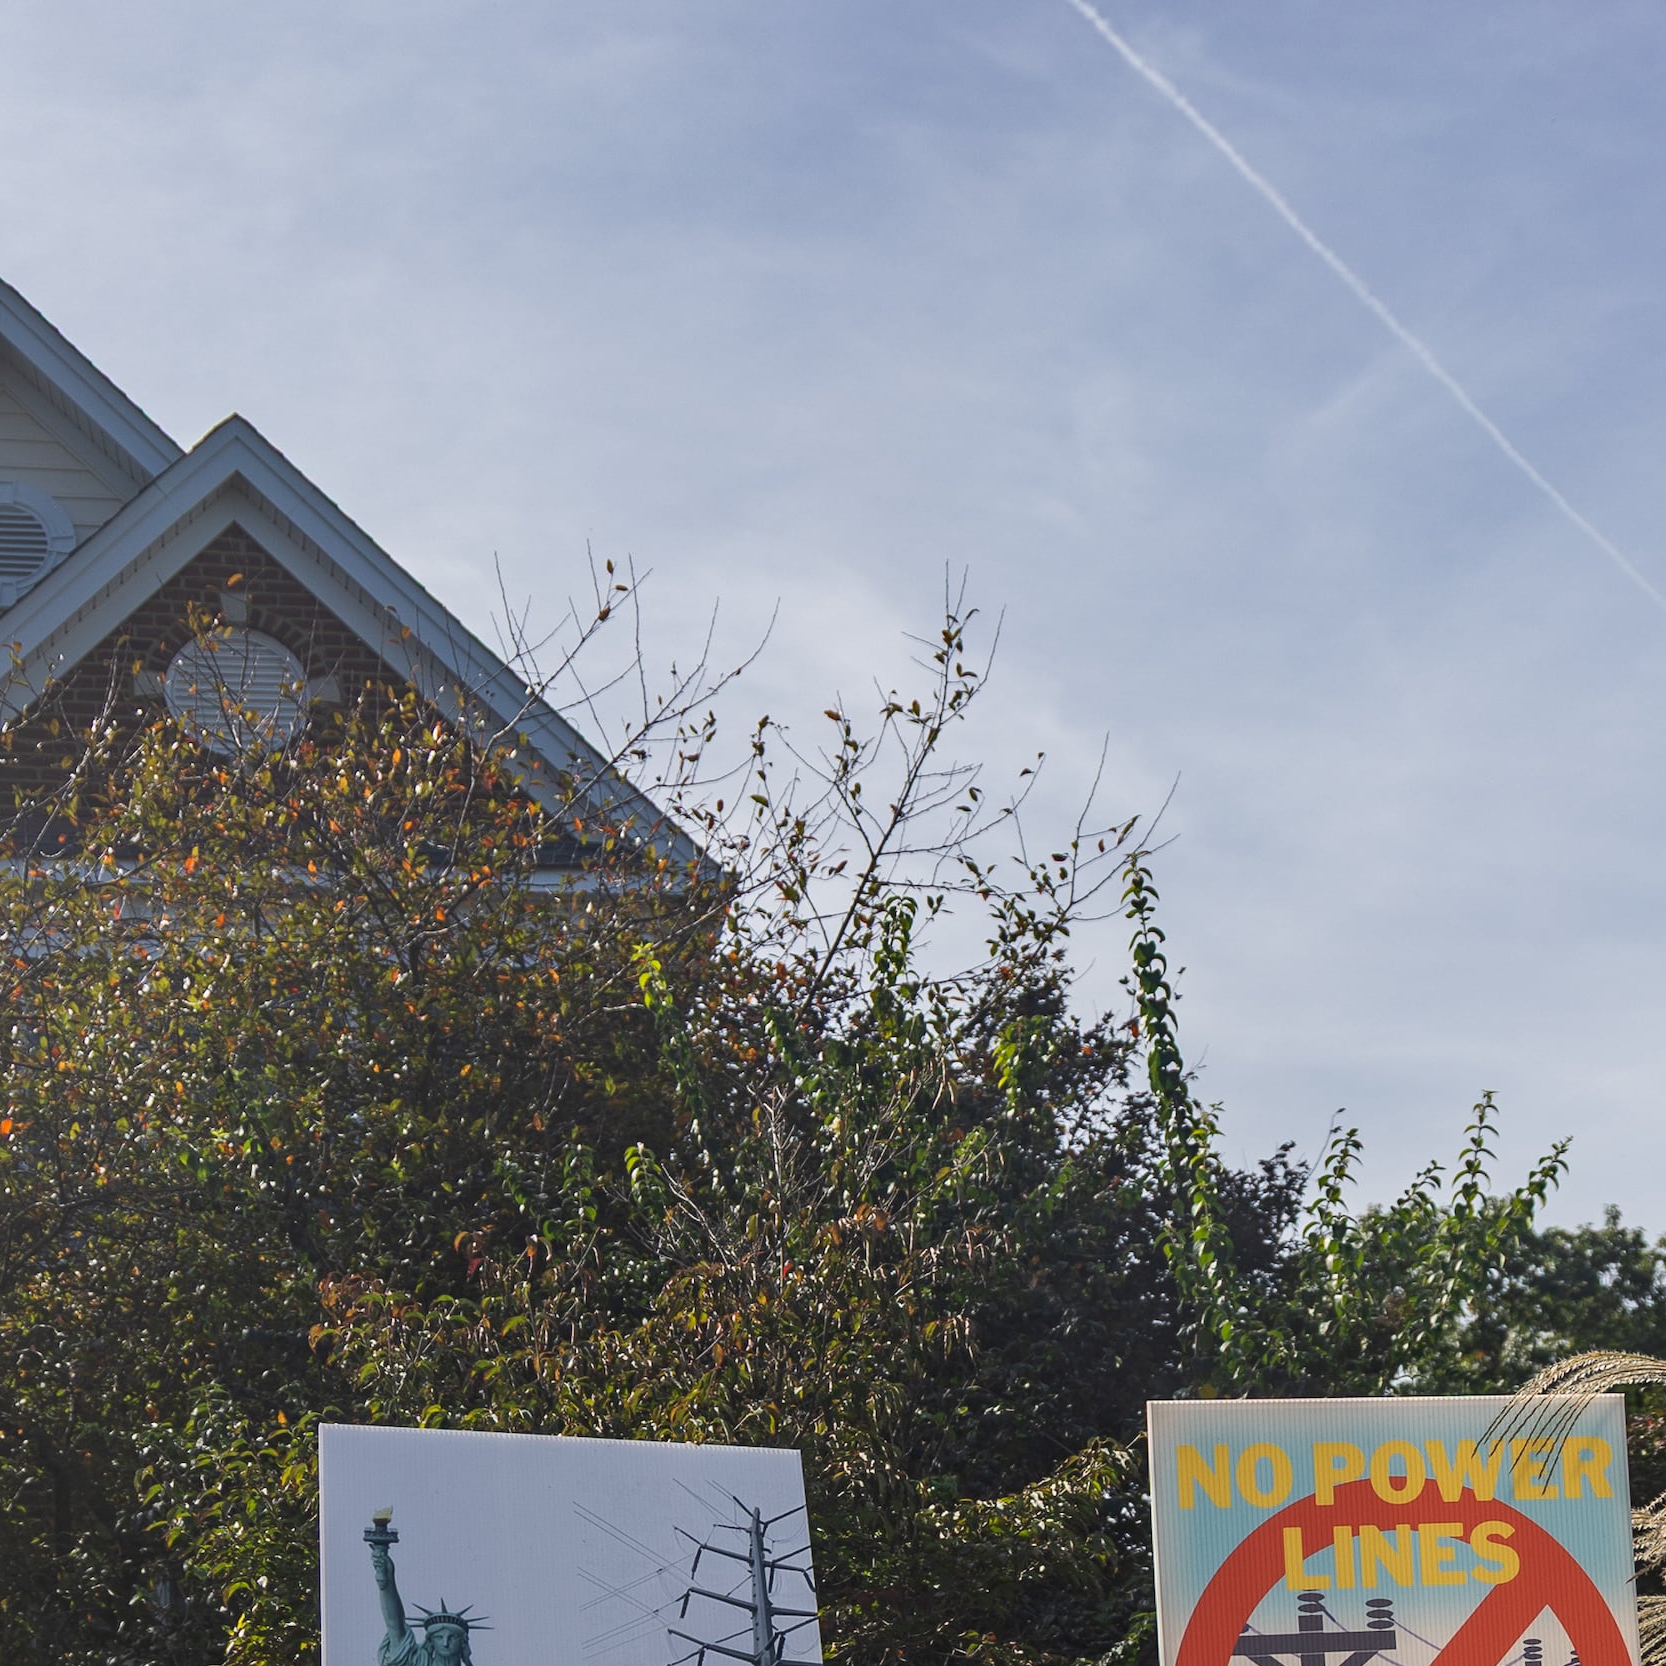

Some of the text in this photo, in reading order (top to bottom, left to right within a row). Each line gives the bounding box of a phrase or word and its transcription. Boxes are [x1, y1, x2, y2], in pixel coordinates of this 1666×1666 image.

[1176, 1436, 1613, 1510] NO POWER
[1282, 1520, 1521, 1591] LINES
